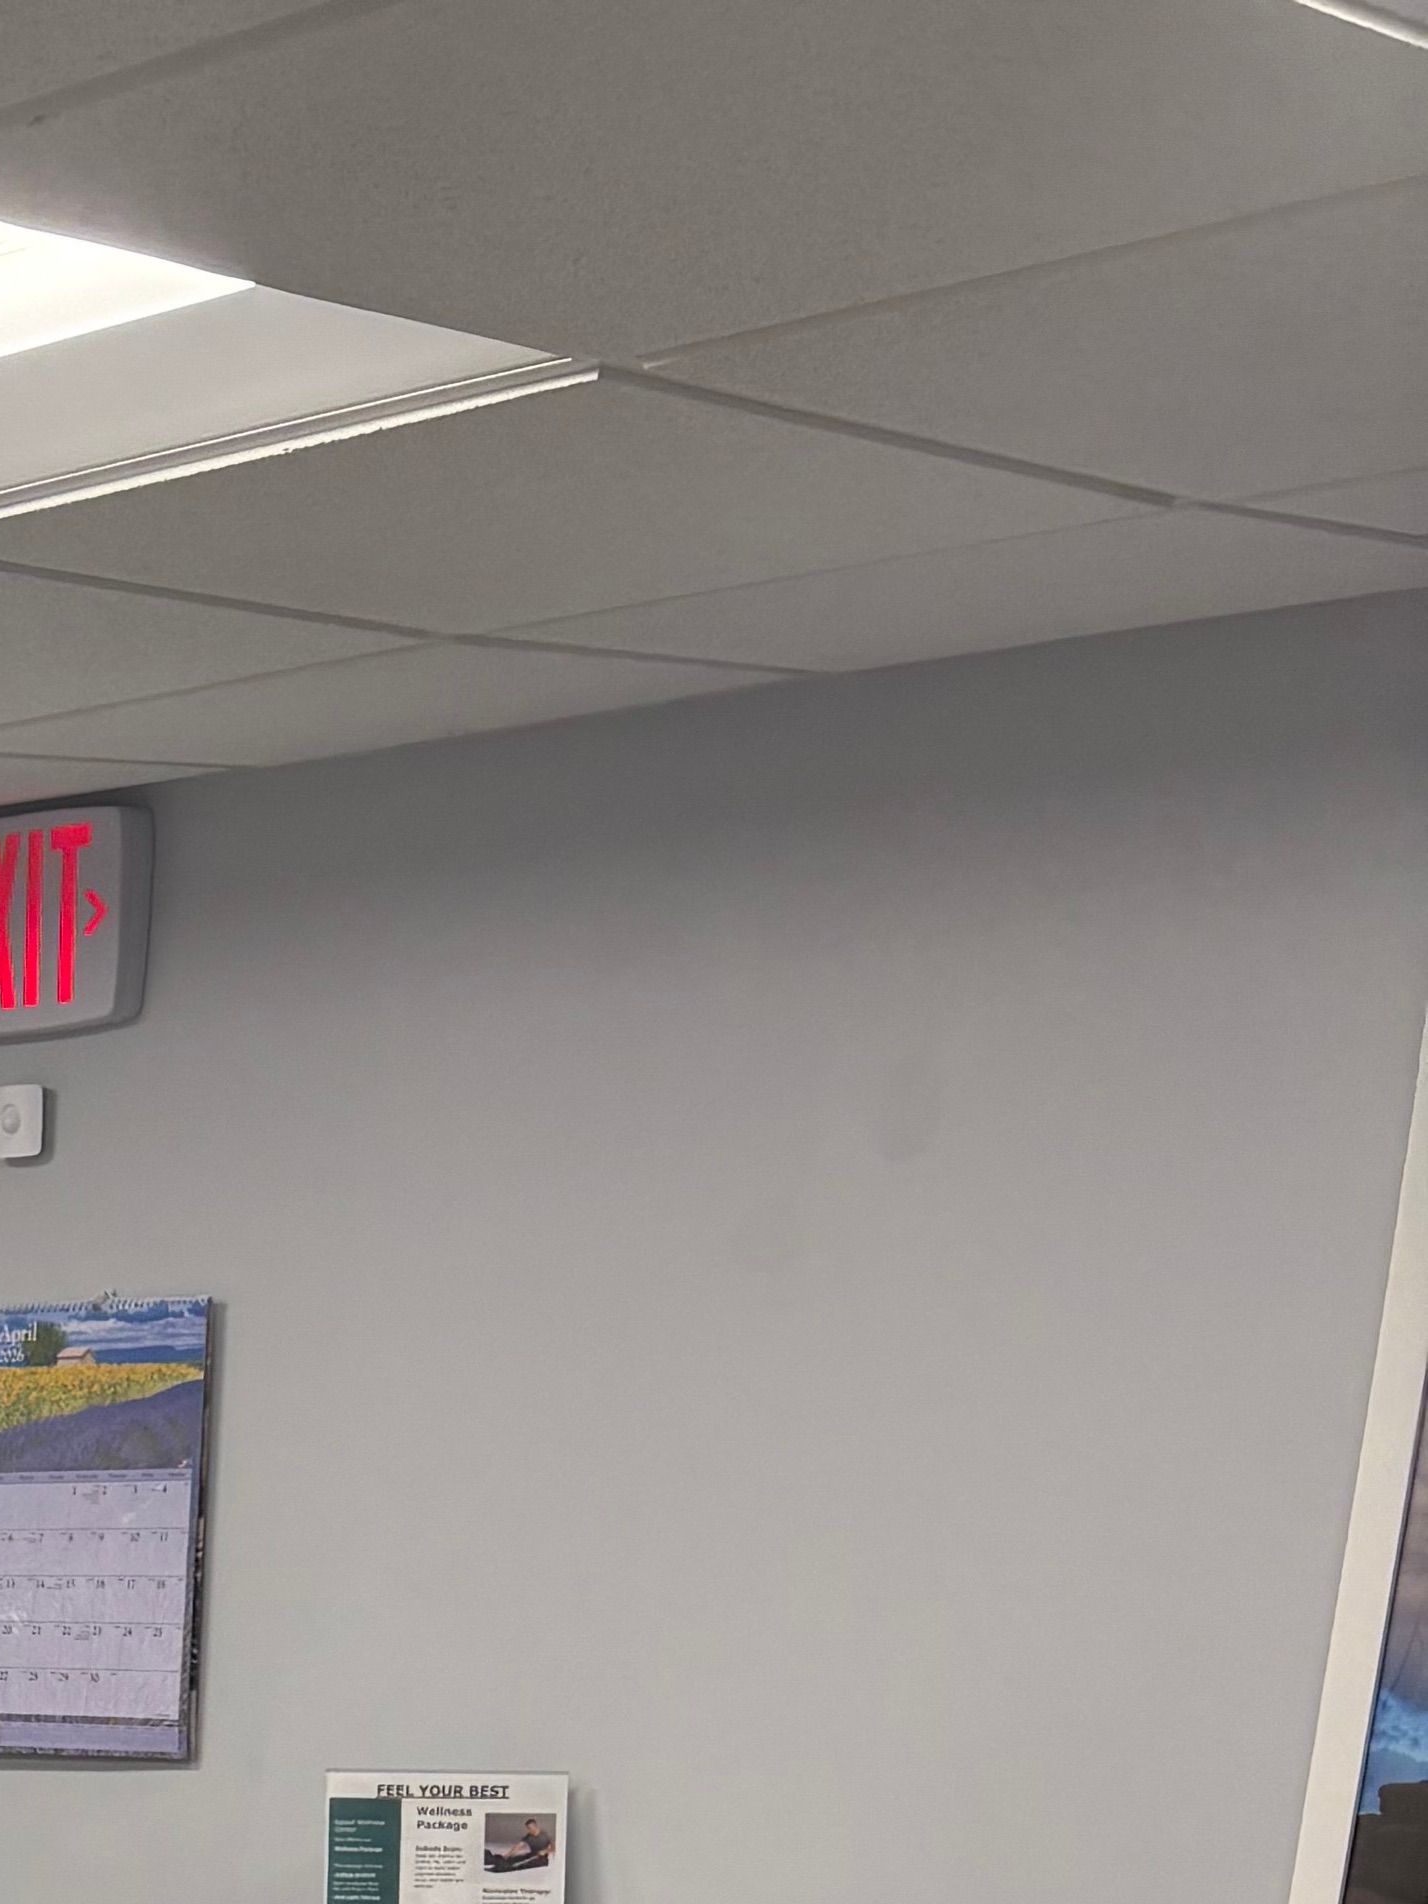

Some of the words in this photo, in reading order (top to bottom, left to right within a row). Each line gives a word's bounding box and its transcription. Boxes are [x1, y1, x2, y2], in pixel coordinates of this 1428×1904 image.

[377, 1784, 414, 1797] FEEL
[419, 1785, 464, 1797] YOUR
[469, 1785, 510, 1798] BEST
[416, 1806, 473, 1817] Wellness
[416, 1820, 468, 1832] Package
